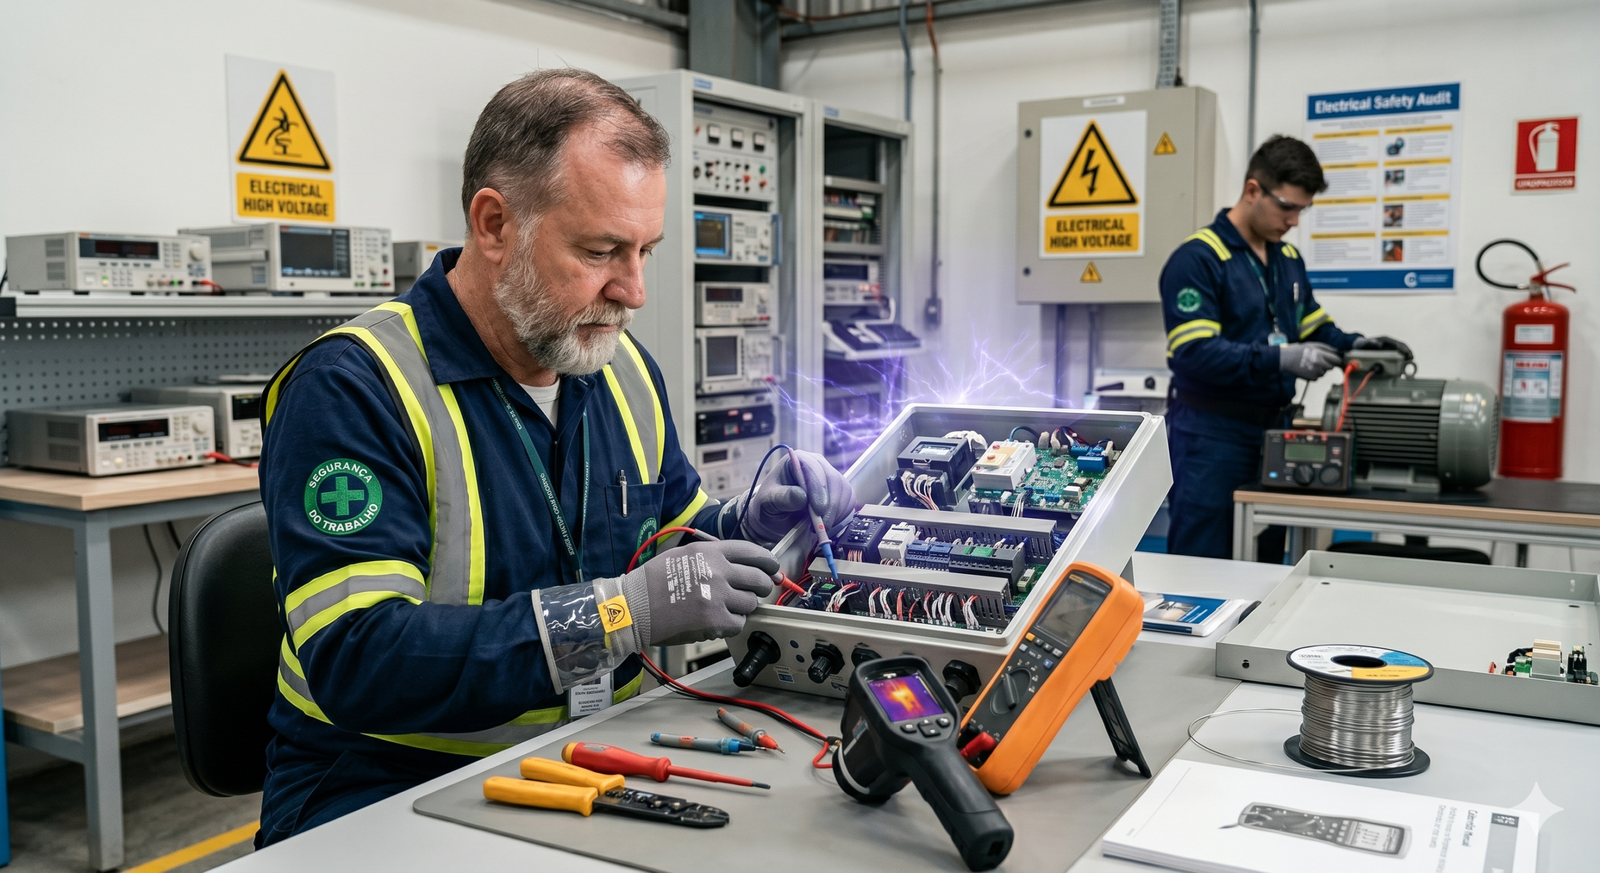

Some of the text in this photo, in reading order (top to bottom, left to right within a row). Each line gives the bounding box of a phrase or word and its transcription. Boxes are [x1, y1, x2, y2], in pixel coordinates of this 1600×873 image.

[1314, 90, 1452, 114] Electrical Safety Audit
[250, 180, 323, 198] ELECTRICAL
[243, 197, 329, 217] HIGH VOLTAGE
[1056, 218, 1125, 233] ELECTRICAL
[1050, 233, 1132, 249] HIGH VOLTAGE
[308, 462, 373, 489] SEGURANÇA
[308, 503, 378, 532] DO TRABALHO
